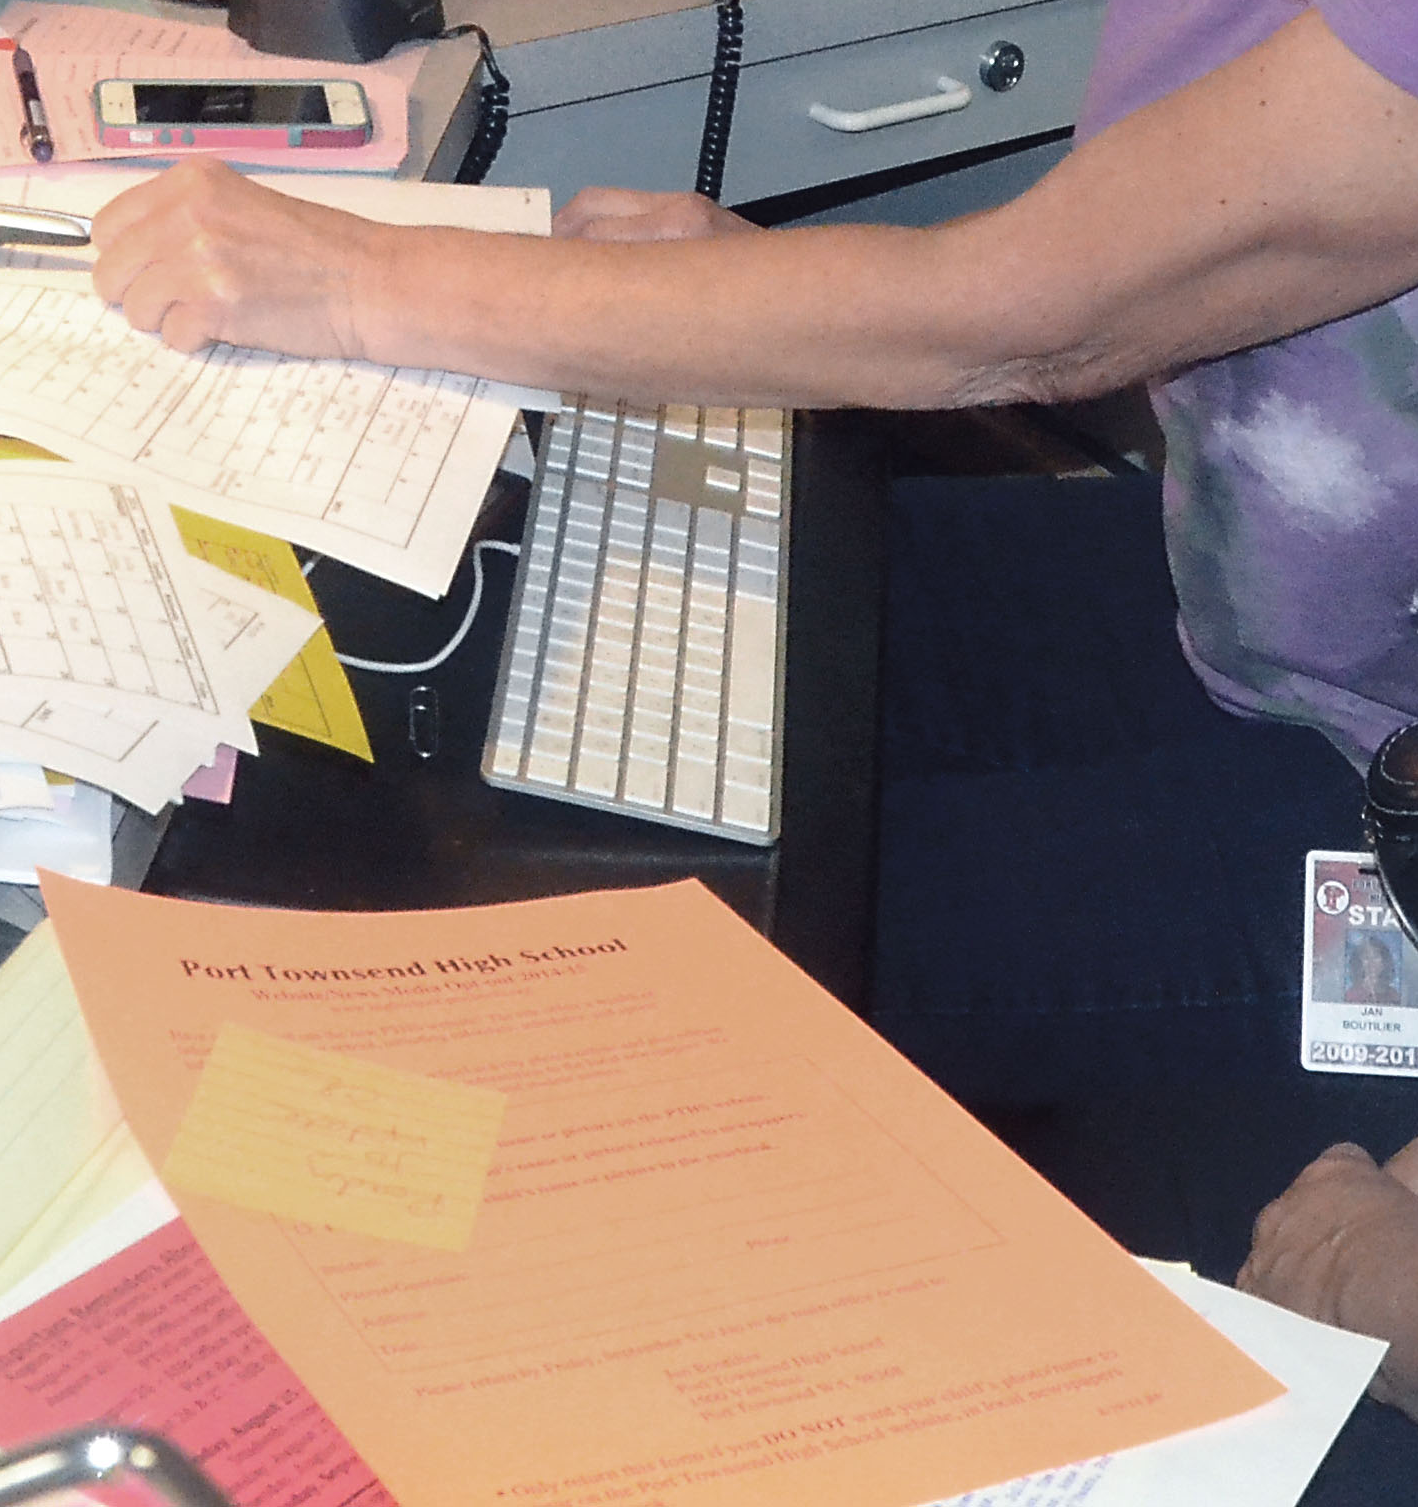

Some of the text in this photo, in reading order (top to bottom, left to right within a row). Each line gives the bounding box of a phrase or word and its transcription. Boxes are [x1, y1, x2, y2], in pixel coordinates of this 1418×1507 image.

[1348, 905, 1399, 928] STA
[179, 936, 630, 986] Port Townsend High School
[1360, 1007, 1384, 1018] JAN
[1341, 1020, 1402, 1033] BOUTILIER
[763, 1428, 798, 1446] DO
[800, 1414, 846, 1434] NOT
